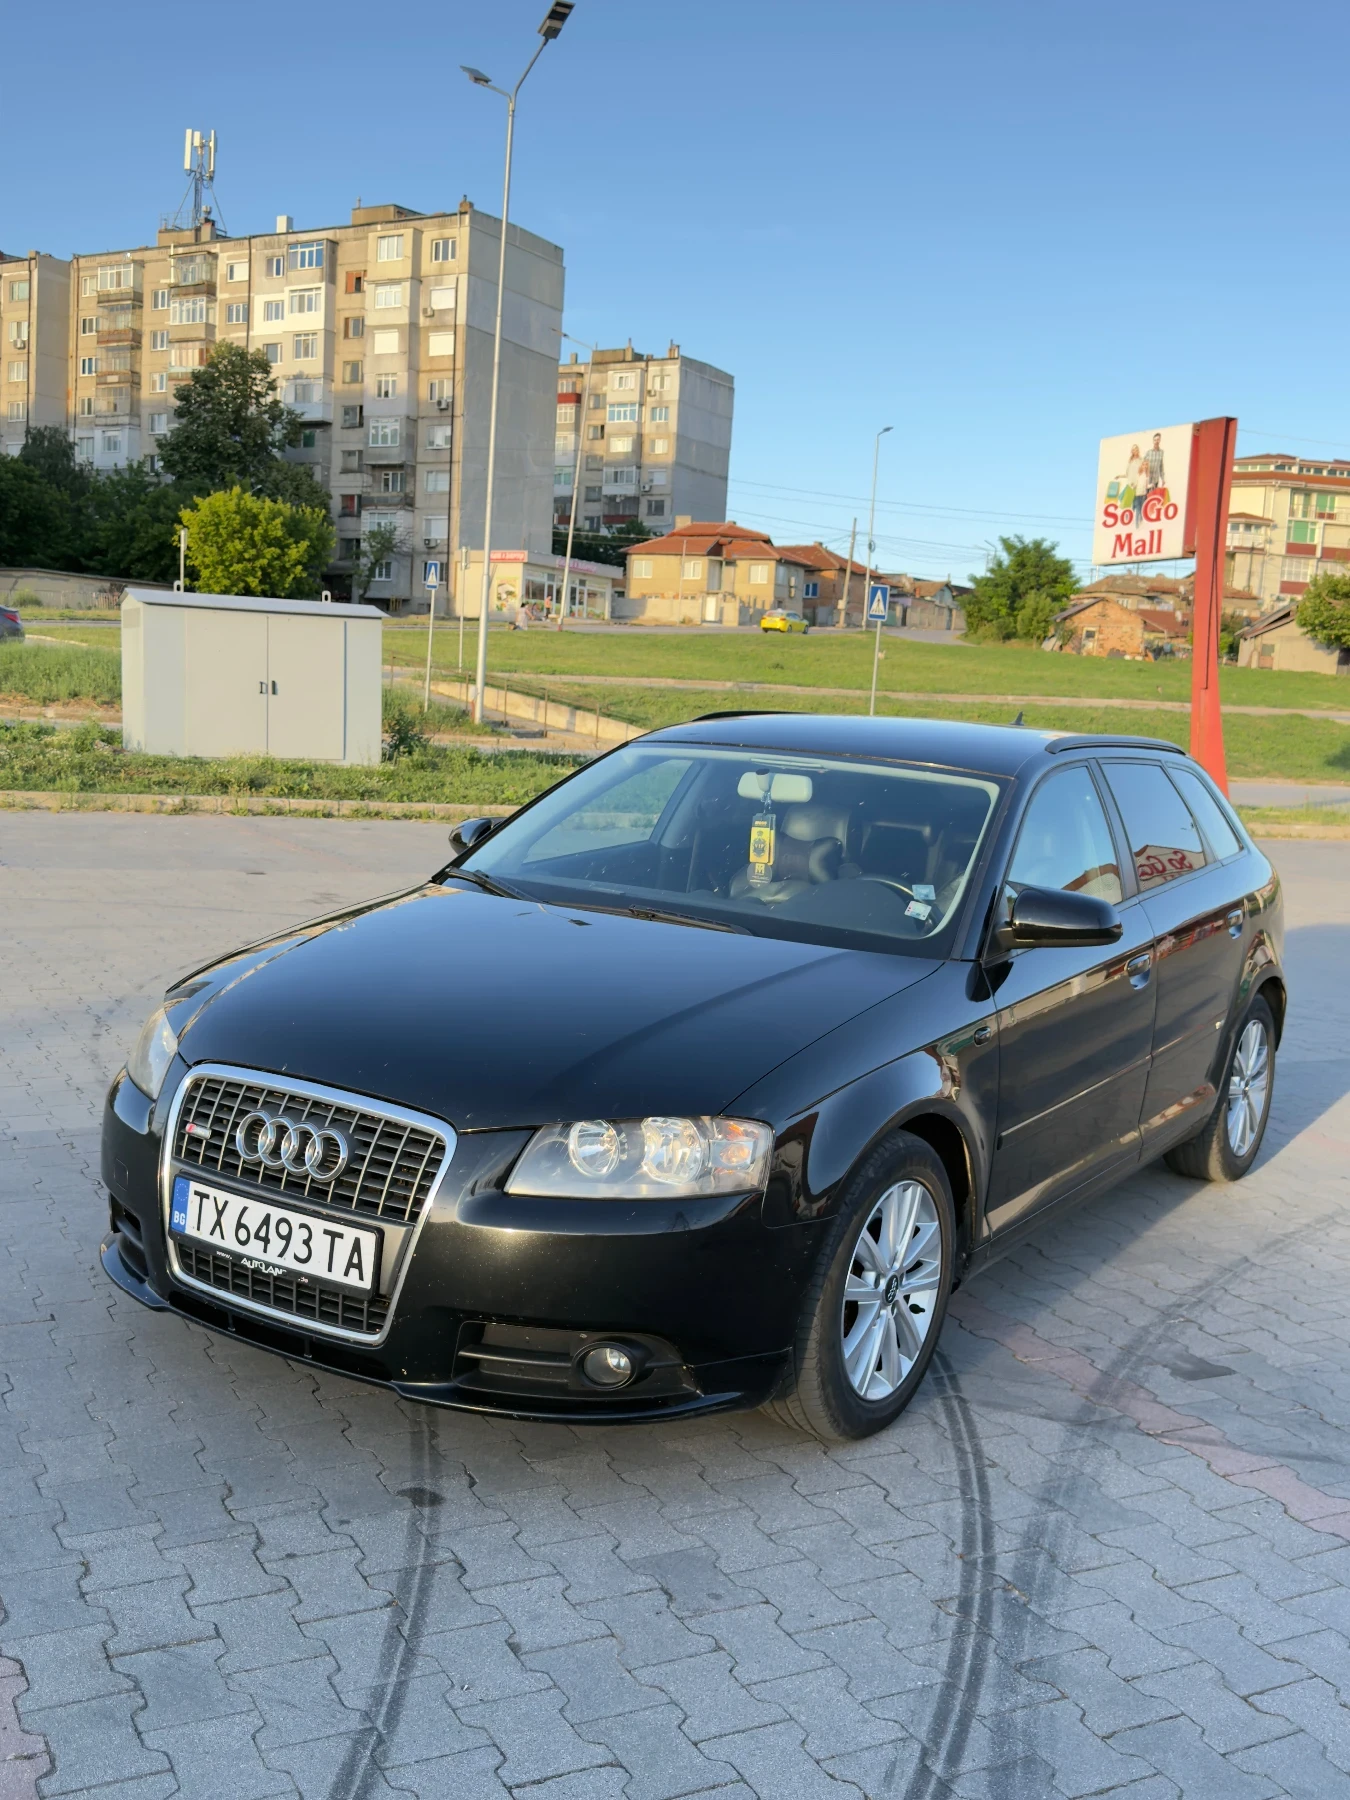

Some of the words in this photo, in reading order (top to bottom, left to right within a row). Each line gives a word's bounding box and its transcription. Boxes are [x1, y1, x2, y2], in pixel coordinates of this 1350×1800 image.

[1102, 503, 1134, 528] So
[1142, 497, 1178, 523] Go
[1111, 529, 1163, 558] Mall
[173, 1211, 186, 1226] BG
[193, 1190, 229, 1240] TX
[234, 1206, 313, 1264] 6493
[322, 1229, 365, 1281] TA
[240, 1257, 287, 1276] AUTOLAN
